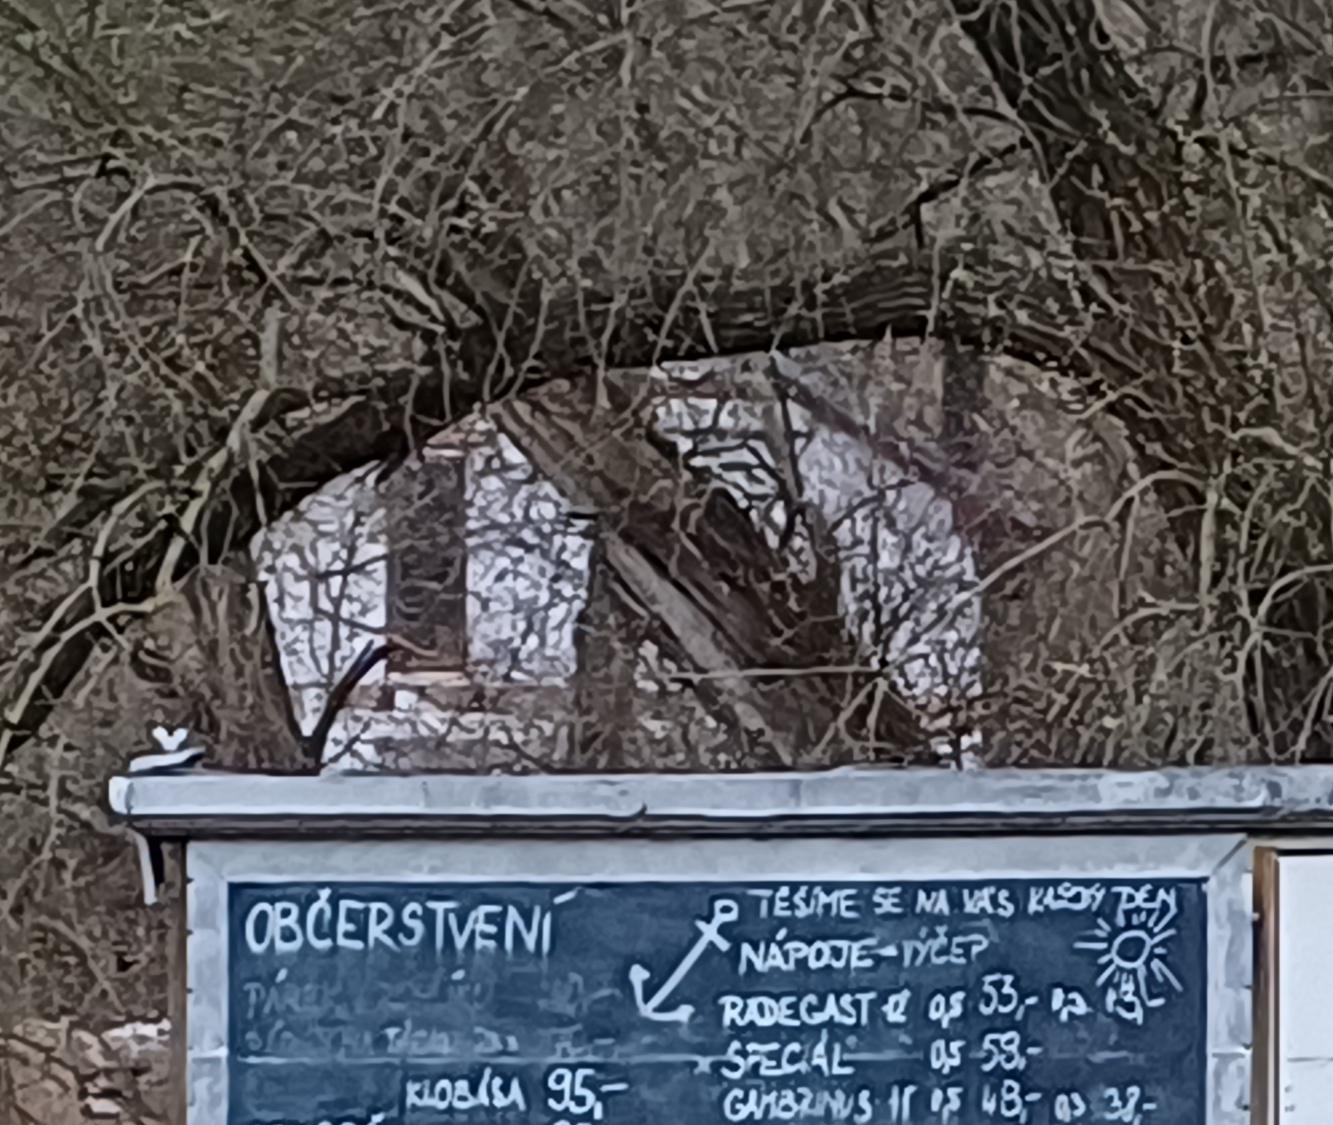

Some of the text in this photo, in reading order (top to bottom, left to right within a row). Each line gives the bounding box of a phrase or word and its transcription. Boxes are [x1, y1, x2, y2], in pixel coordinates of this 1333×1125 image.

[245, 888, 581, 955] OBČERSTVENÍ
[872, 887, 903, 914] SE
[915, 889, 949, 915] NA
[718, 991, 878, 1028] RADEGAST
[720, 1029, 855, 1079] SPECIÁL
[547, 1068, 629, 1119] 95,-
